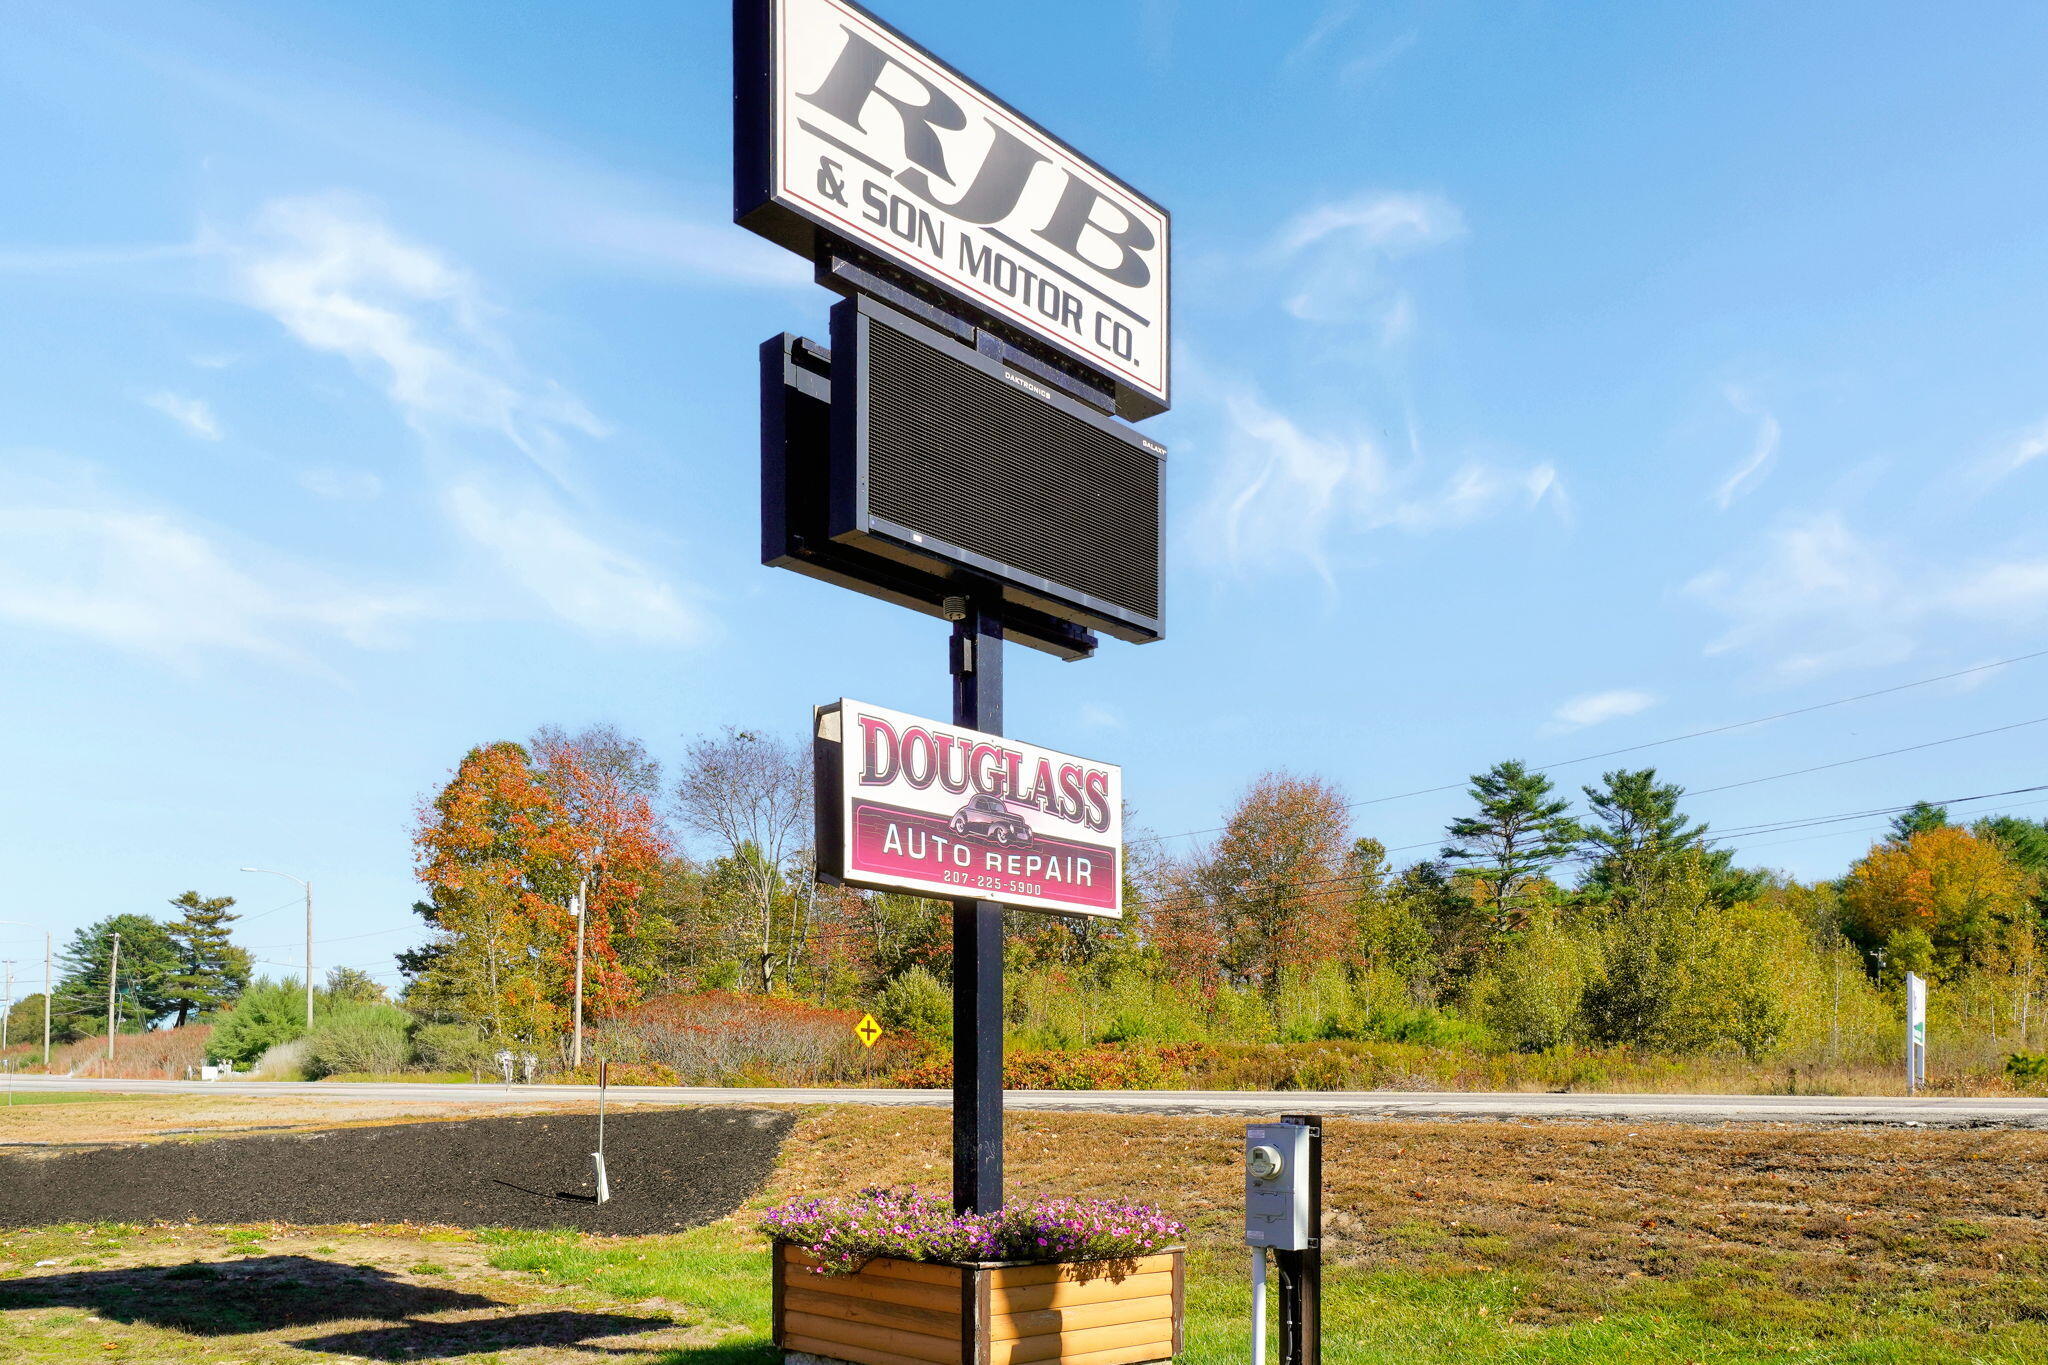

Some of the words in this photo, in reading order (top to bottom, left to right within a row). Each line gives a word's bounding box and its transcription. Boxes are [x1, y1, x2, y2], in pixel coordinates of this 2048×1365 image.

[795, 24, 1155, 289] RJB
[816, 154, 848, 208] &
[862, 179, 944, 260] SON
[959, 231, 1083, 336] MOTOR
[1095, 311, 1139, 367] CO.
[1004, 371, 1051, 399] DAKTRONICS
[858, 713, 1111, 833] DOUGLASS
[883, 823, 971, 867] AUTO
[986, 851, 1092, 887] REPAIR
[943, 869, 1041, 895] 207-225-5900
